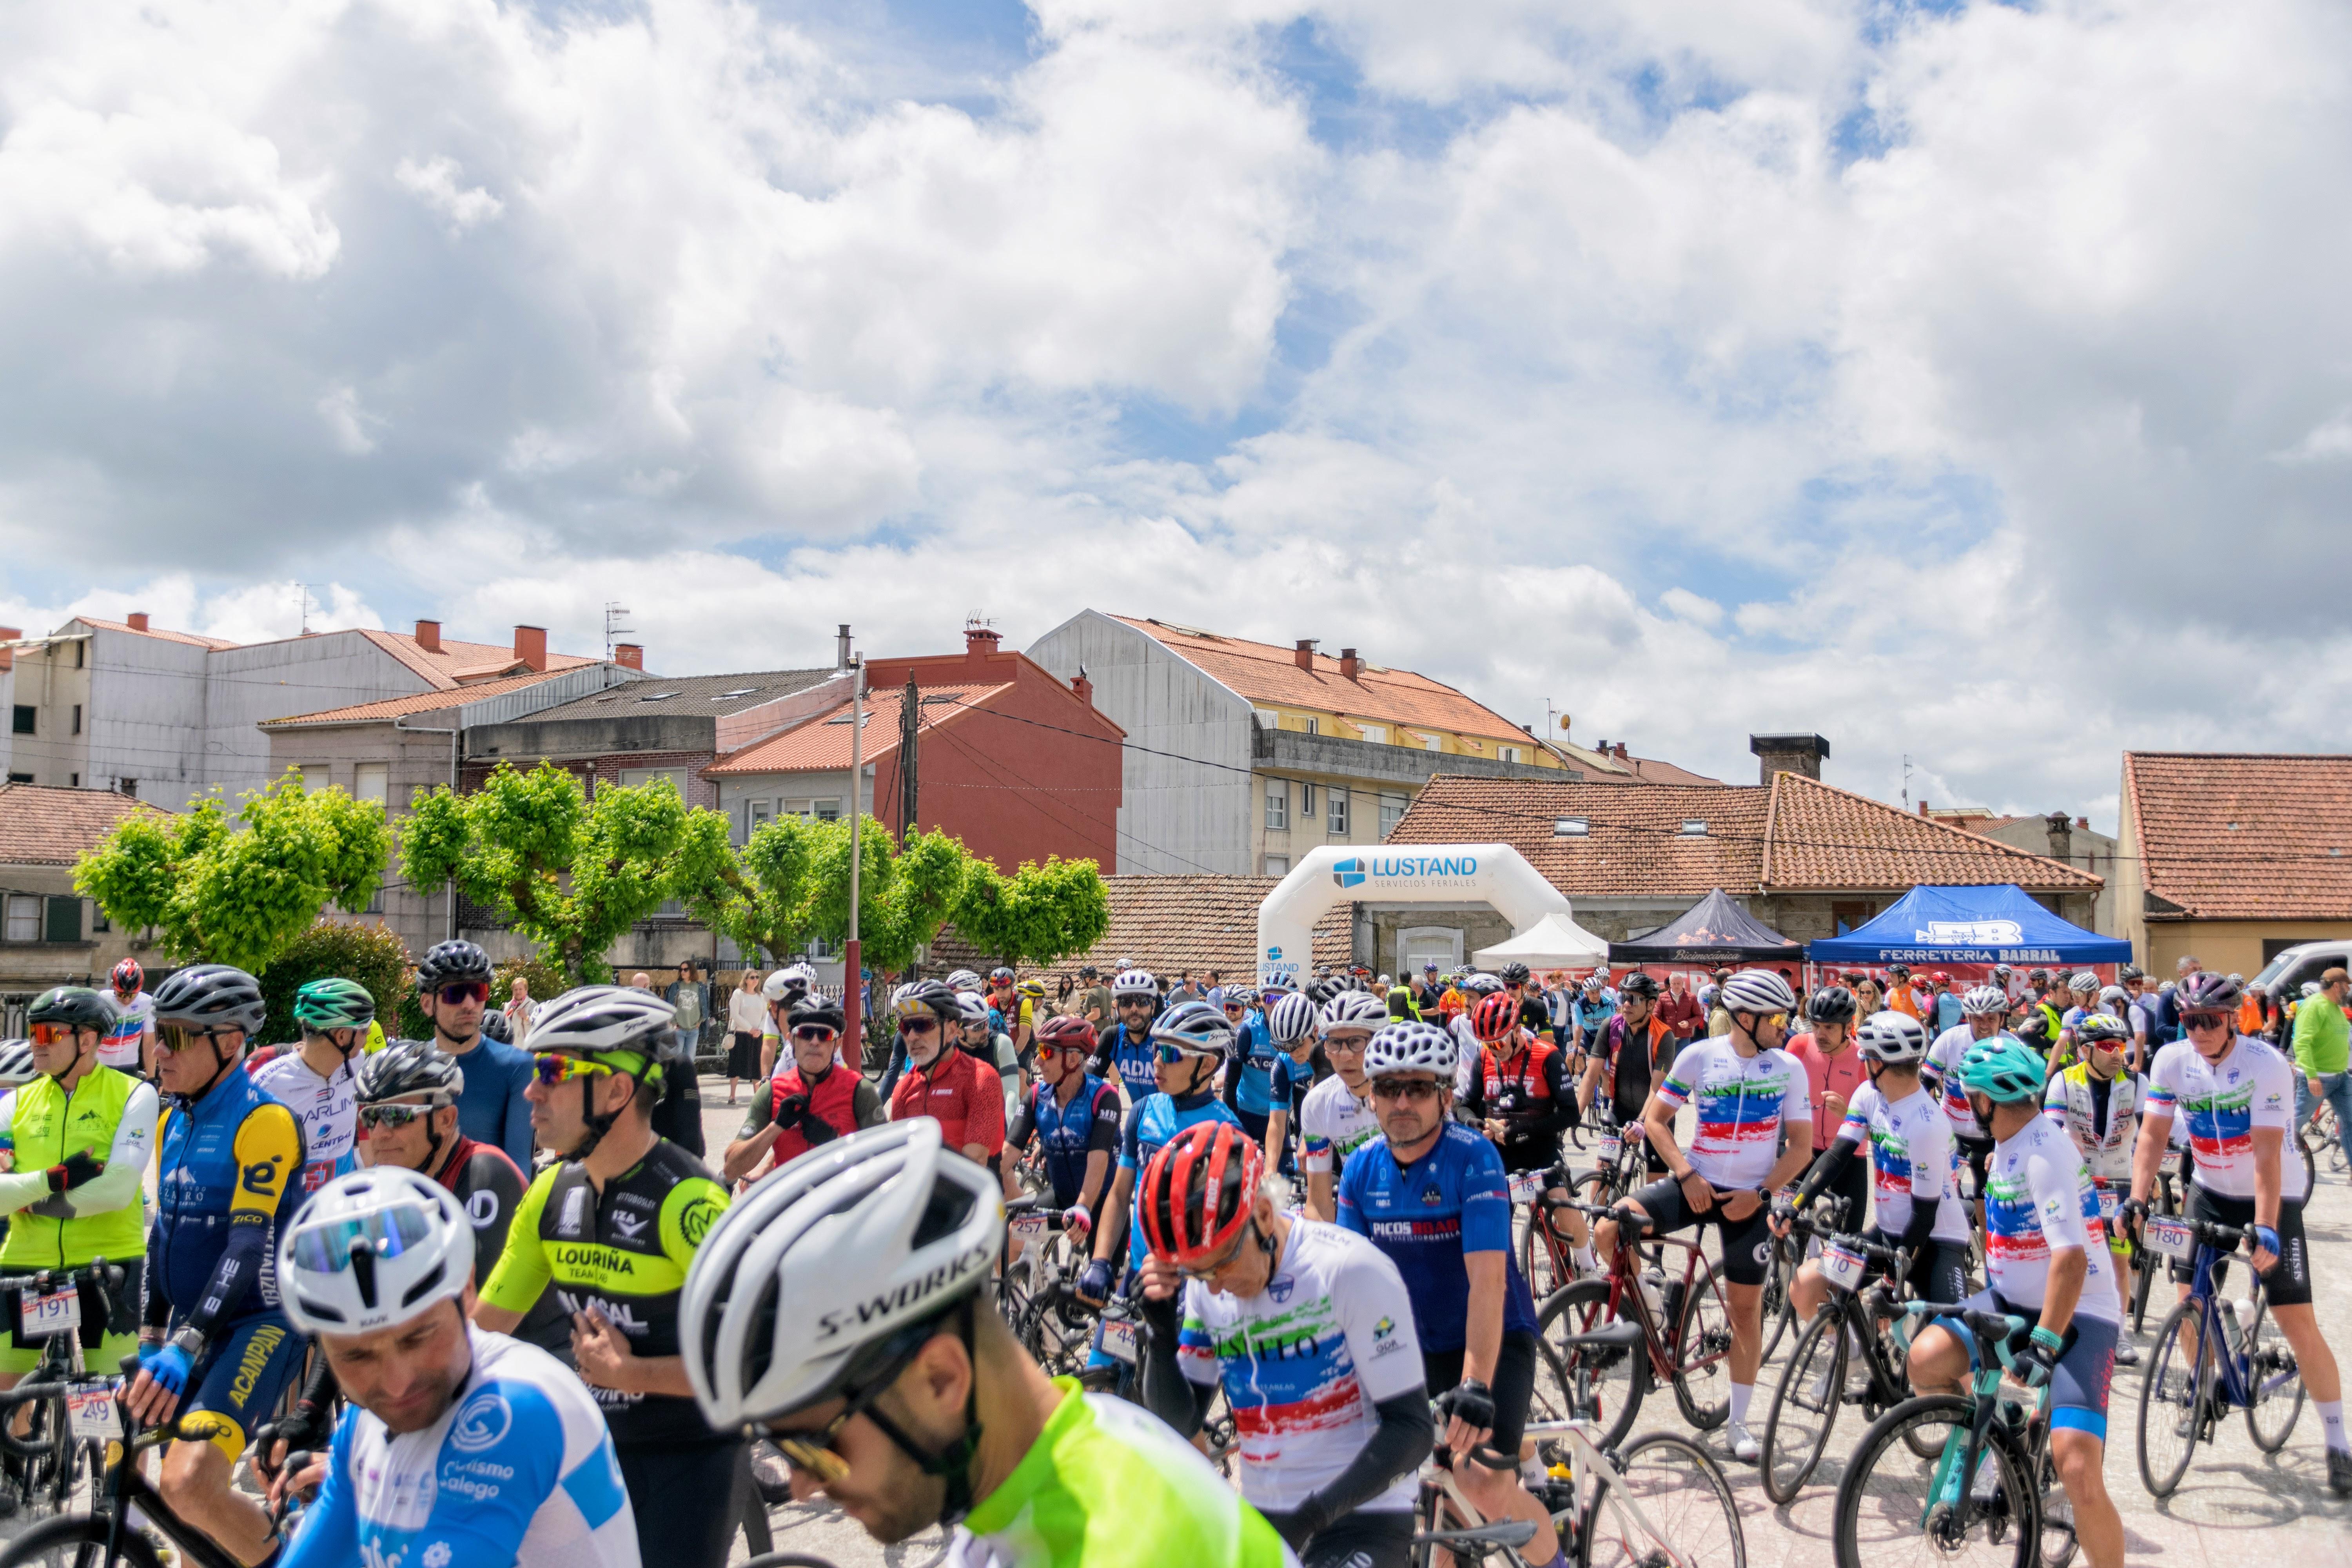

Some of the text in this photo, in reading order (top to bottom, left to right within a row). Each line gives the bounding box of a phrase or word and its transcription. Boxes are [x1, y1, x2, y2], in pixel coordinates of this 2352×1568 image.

[1373, 857, 1477, 877] LUSTAND
[1671, 949, 1740, 961] Bicimecánica
[1879, 949, 2060, 962] FERRETERIA BARRAL
[1258, 962, 1299, 972] LUSTAND
[256, 1061, 286, 1085] ENTRAL
[1120, 1058, 1155, 1077] ADN
[1125, 1076, 1153, 1085] BIKERS
[1601, 1141, 1616, 1151] 239
[1520, 1181, 1535, 1192] 18
[232, 1214, 263, 1224] ZICO
[612, 1209, 636, 1224] IZA
[1017, 1222, 1042, 1233] 257
[2155, 1227, 2183, 1246] 180
[556, 1247, 635, 1275] LOURIÑA
[1831, 1255, 1849, 1273] 10
[570, 1267, 594, 1279] TEAM
[815, 1244, 991, 1340] S-WORKS
[38, 1298, 69, 1319] 191
[230, 1324, 286, 1409] ACANPAN
[82, 1399, 110, 1421] 249
[133, 1429, 158, 1444] BMC
